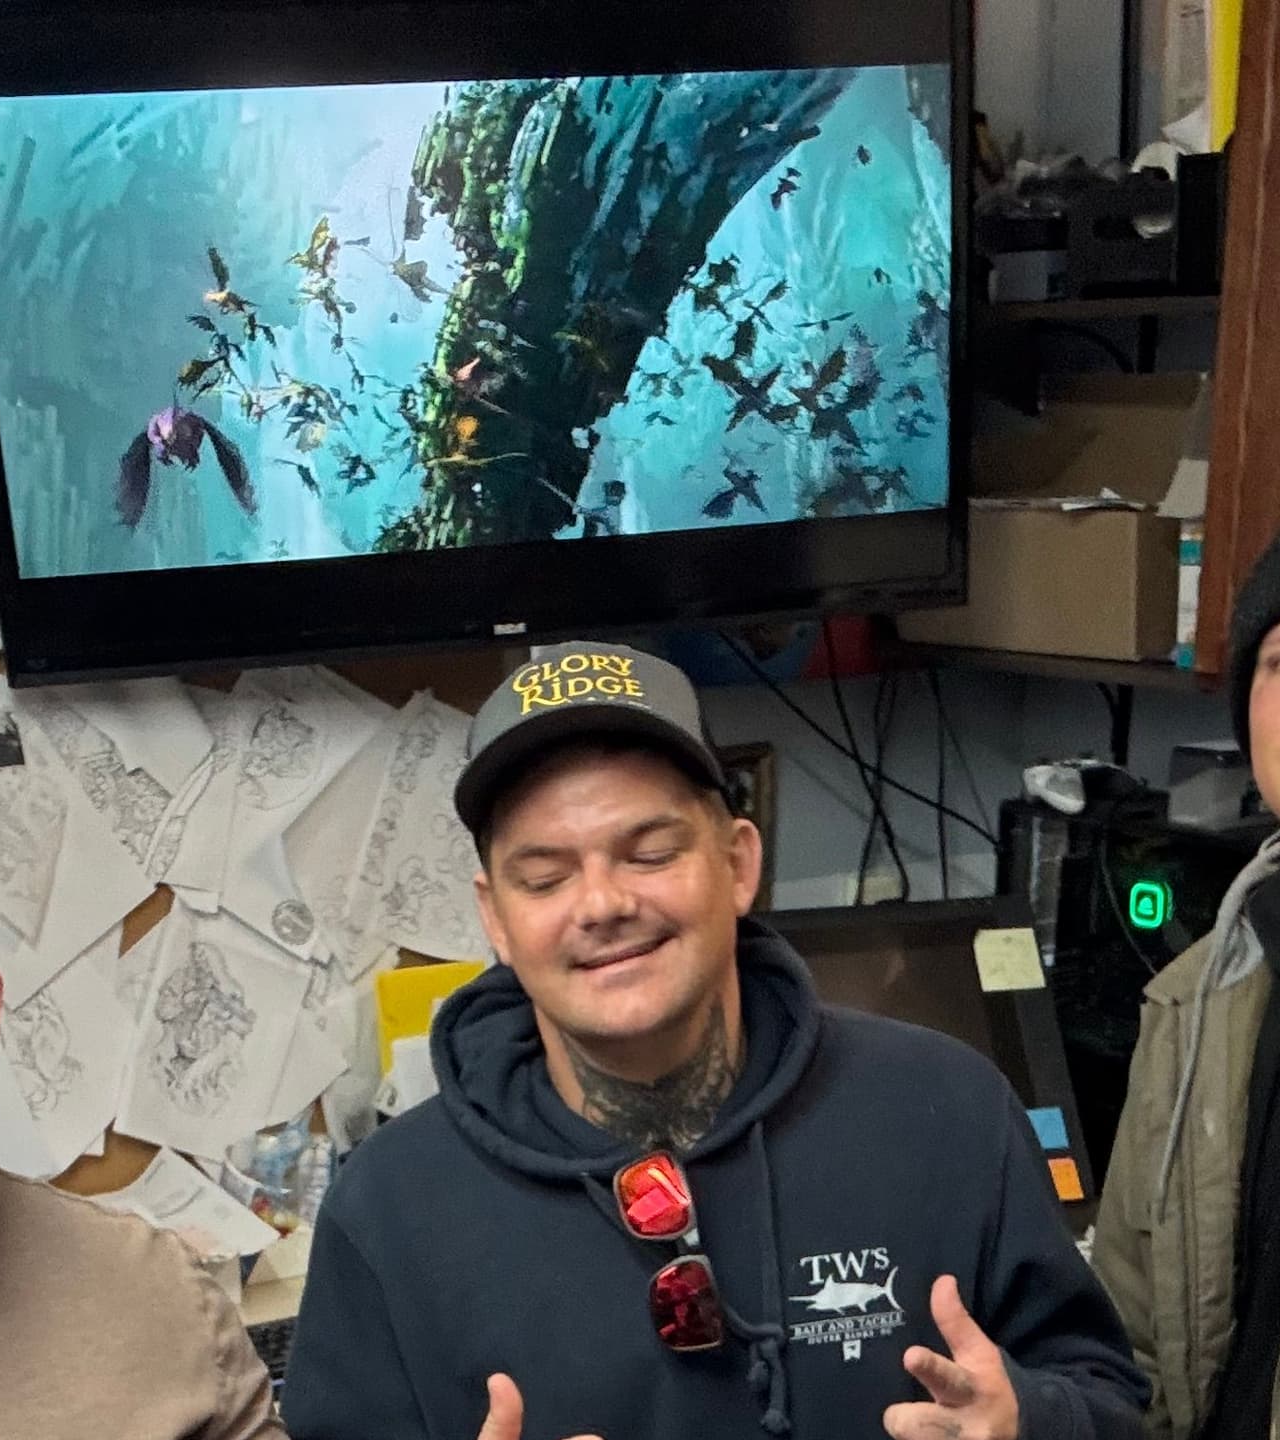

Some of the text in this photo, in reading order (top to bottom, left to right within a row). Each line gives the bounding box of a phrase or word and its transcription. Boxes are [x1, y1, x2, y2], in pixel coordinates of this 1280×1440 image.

[512, 653, 634, 693] GLORY
[521, 676, 645, 715] RIDGE
[799, 1247, 891, 1285] TW'S
[794, 1312, 901, 1337] BAIT AND TACKLE
